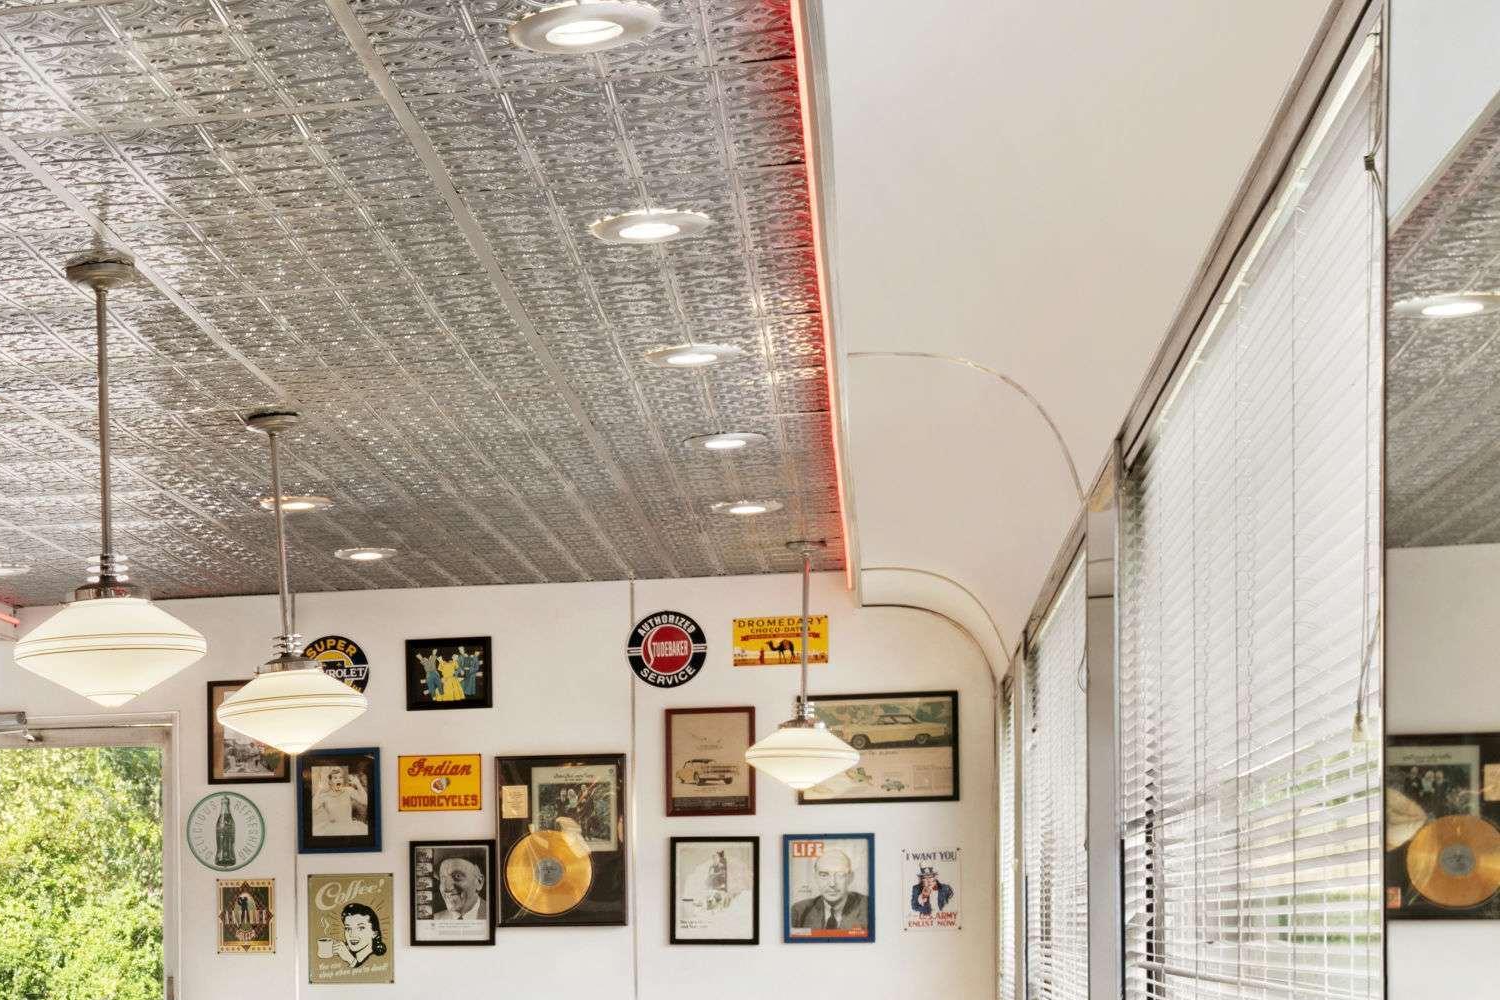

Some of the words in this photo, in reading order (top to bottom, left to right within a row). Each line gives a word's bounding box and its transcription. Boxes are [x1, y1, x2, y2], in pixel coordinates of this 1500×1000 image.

[637, 614, 696, 637] AUTHORIZED
[306, 638, 357, 660] SUPER
[639, 665, 697, 686] SERVICE
[407, 758, 472, 777] Indian
[402, 794, 478, 808] MOTORCYCLES
[793, 842, 824, 857] LIFE
[906, 852, 910, 861] I
[912, 851, 937, 861] WANT
[940, 850, 957, 861] YOU
[936, 911, 958, 920] ARMY
[908, 920, 934, 928] ENLIST
